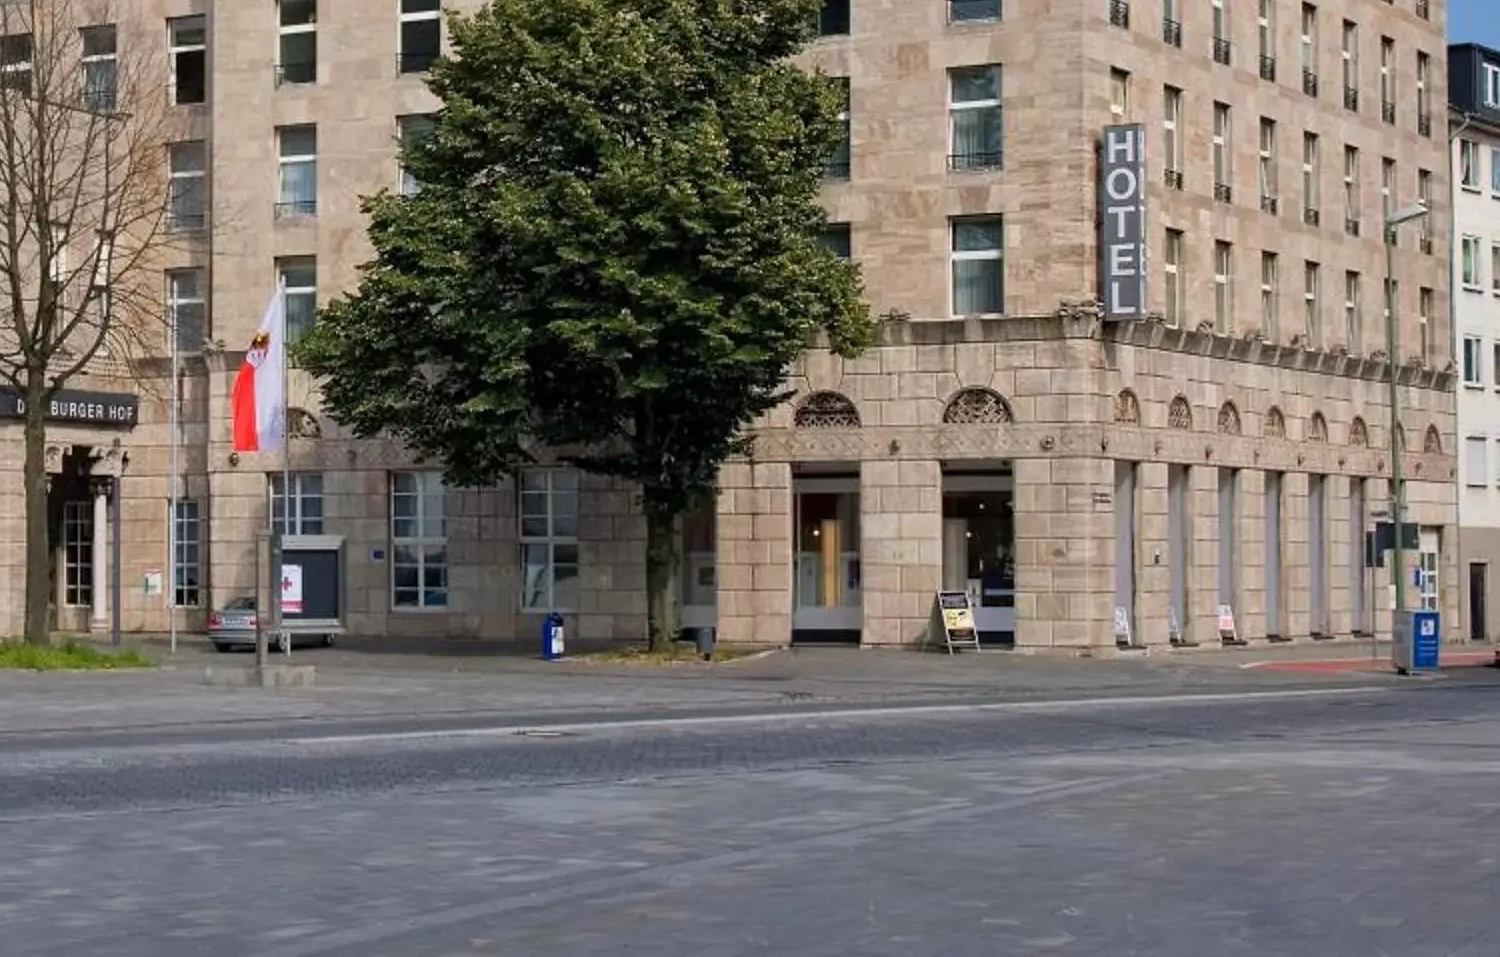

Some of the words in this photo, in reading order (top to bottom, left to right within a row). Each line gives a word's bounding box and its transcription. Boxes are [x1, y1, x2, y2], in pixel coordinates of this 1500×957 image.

[1106, 130, 1136, 314] HOTEL
[17, 398, 104, 420] DBURGER
[109, 404, 133, 420] HOF
